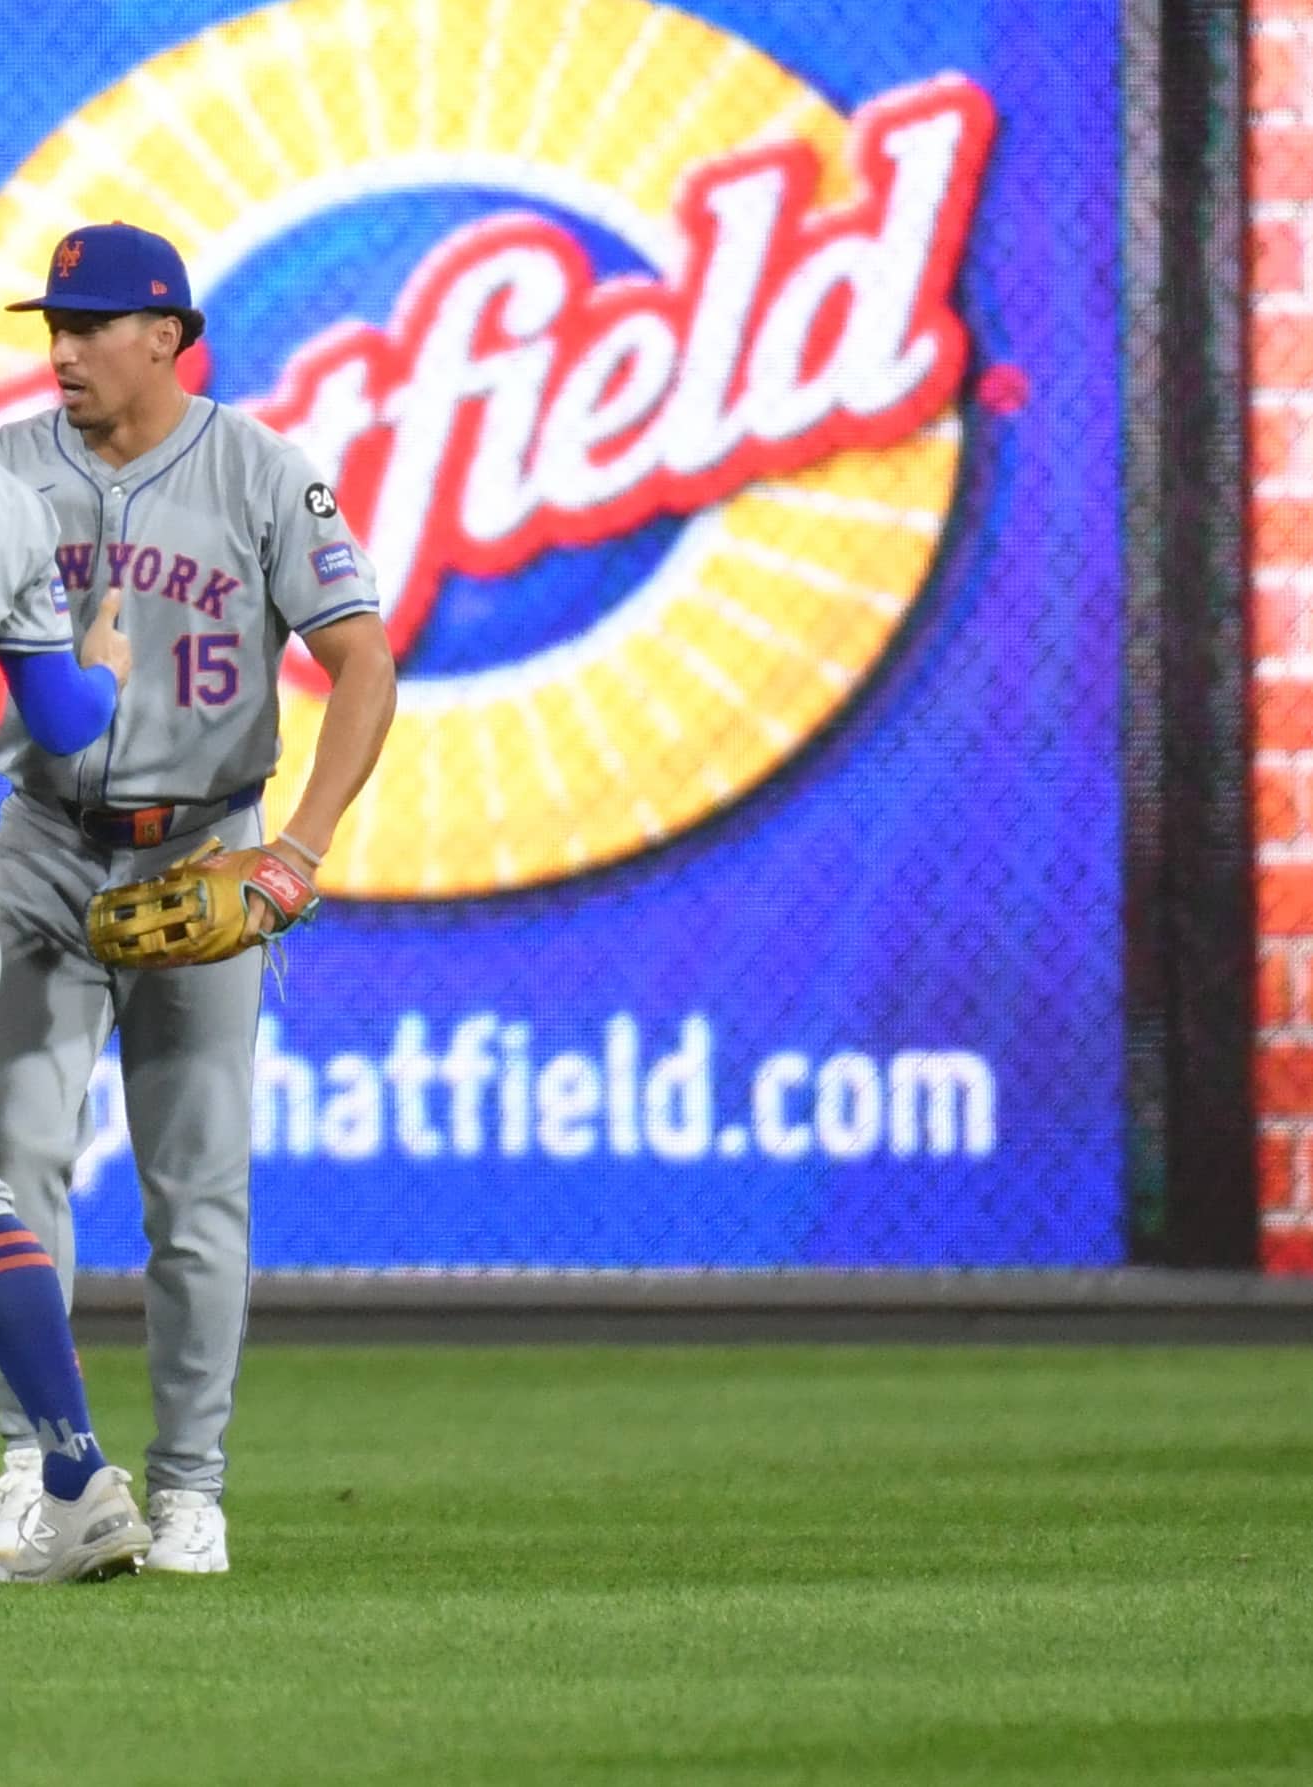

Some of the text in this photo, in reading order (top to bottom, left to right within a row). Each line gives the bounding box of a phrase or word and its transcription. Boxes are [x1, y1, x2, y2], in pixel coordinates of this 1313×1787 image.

[247, 72, 993, 696] tfield
[309, 487, 336, 514] 24
[106, 542, 243, 620] YORK
[171, 632, 241, 708] 15
